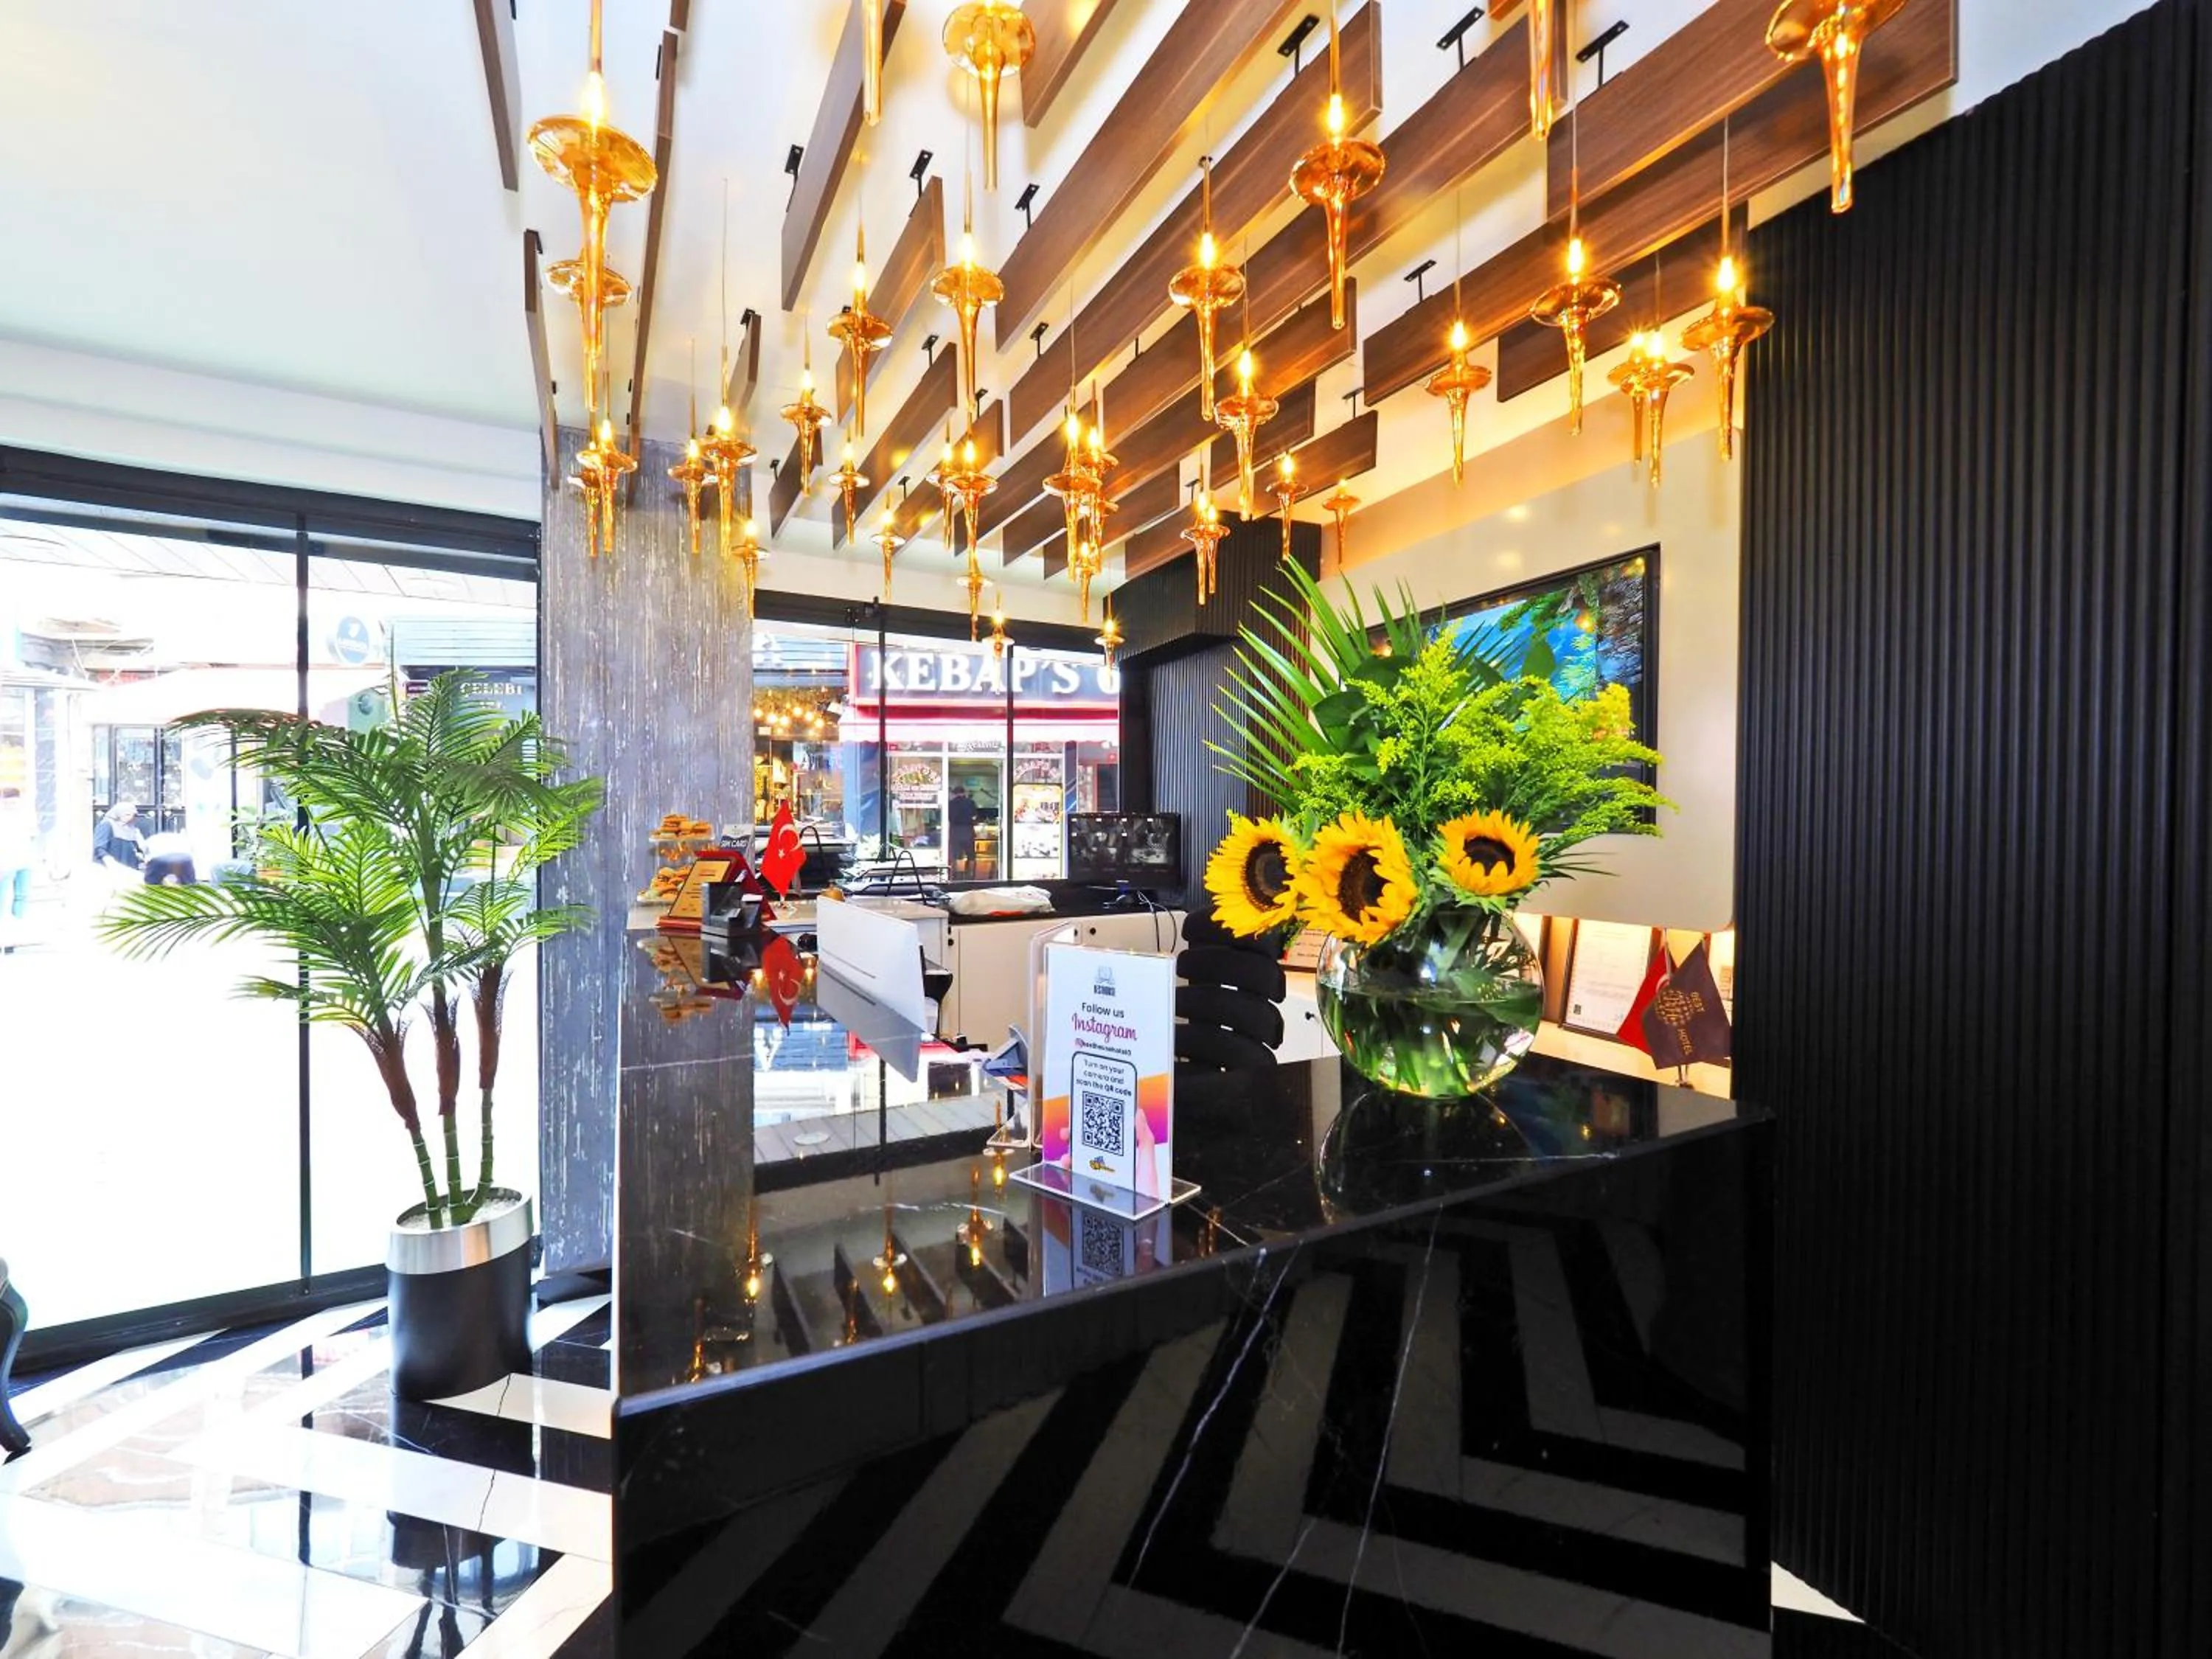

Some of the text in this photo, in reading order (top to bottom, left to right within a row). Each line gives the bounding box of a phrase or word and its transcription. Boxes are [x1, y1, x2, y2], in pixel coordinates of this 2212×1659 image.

[1082, 1002, 1125, 1018] Follow us
[1071, 1012, 1137, 1043] Instagram
[1084, 1058, 1098, 1068] Turn
[1108, 1065, 1124, 1074] your
[1083, 1070, 1124, 1085] camera and
[1076, 1079, 1132, 1096] scan the QR code
